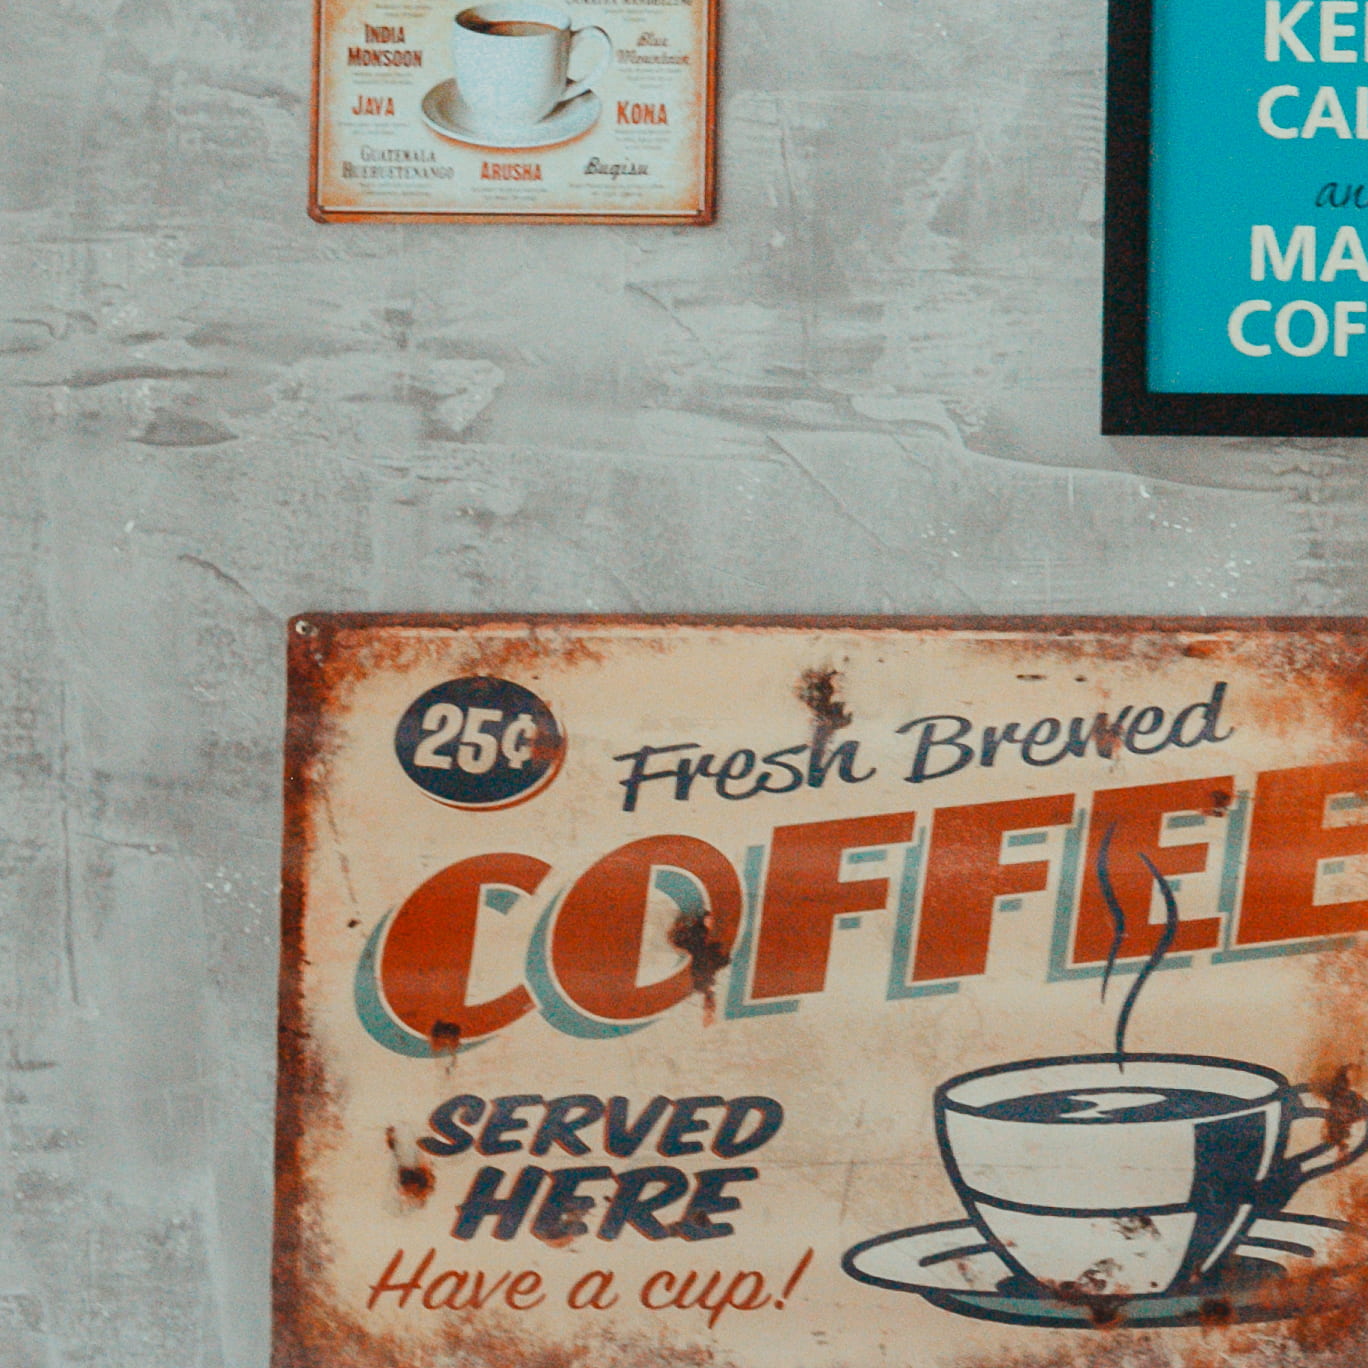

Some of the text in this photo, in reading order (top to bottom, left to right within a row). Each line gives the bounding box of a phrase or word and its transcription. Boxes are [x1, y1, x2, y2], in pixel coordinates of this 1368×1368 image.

[364, 22, 406, 44] INDIA
[347, 46, 423, 68] MONSOON
[352, 94, 396, 117] JAVA
[616, 100, 669, 126] KONA
[479, 161, 544, 182] ARUSHA
[612, 681, 1236, 814] Fresh Brewed
[416, 1092, 785, 1160] SERVED
[448, 1165, 760, 1245] HERE
[364, 1246, 812, 1330] Have a cup!
